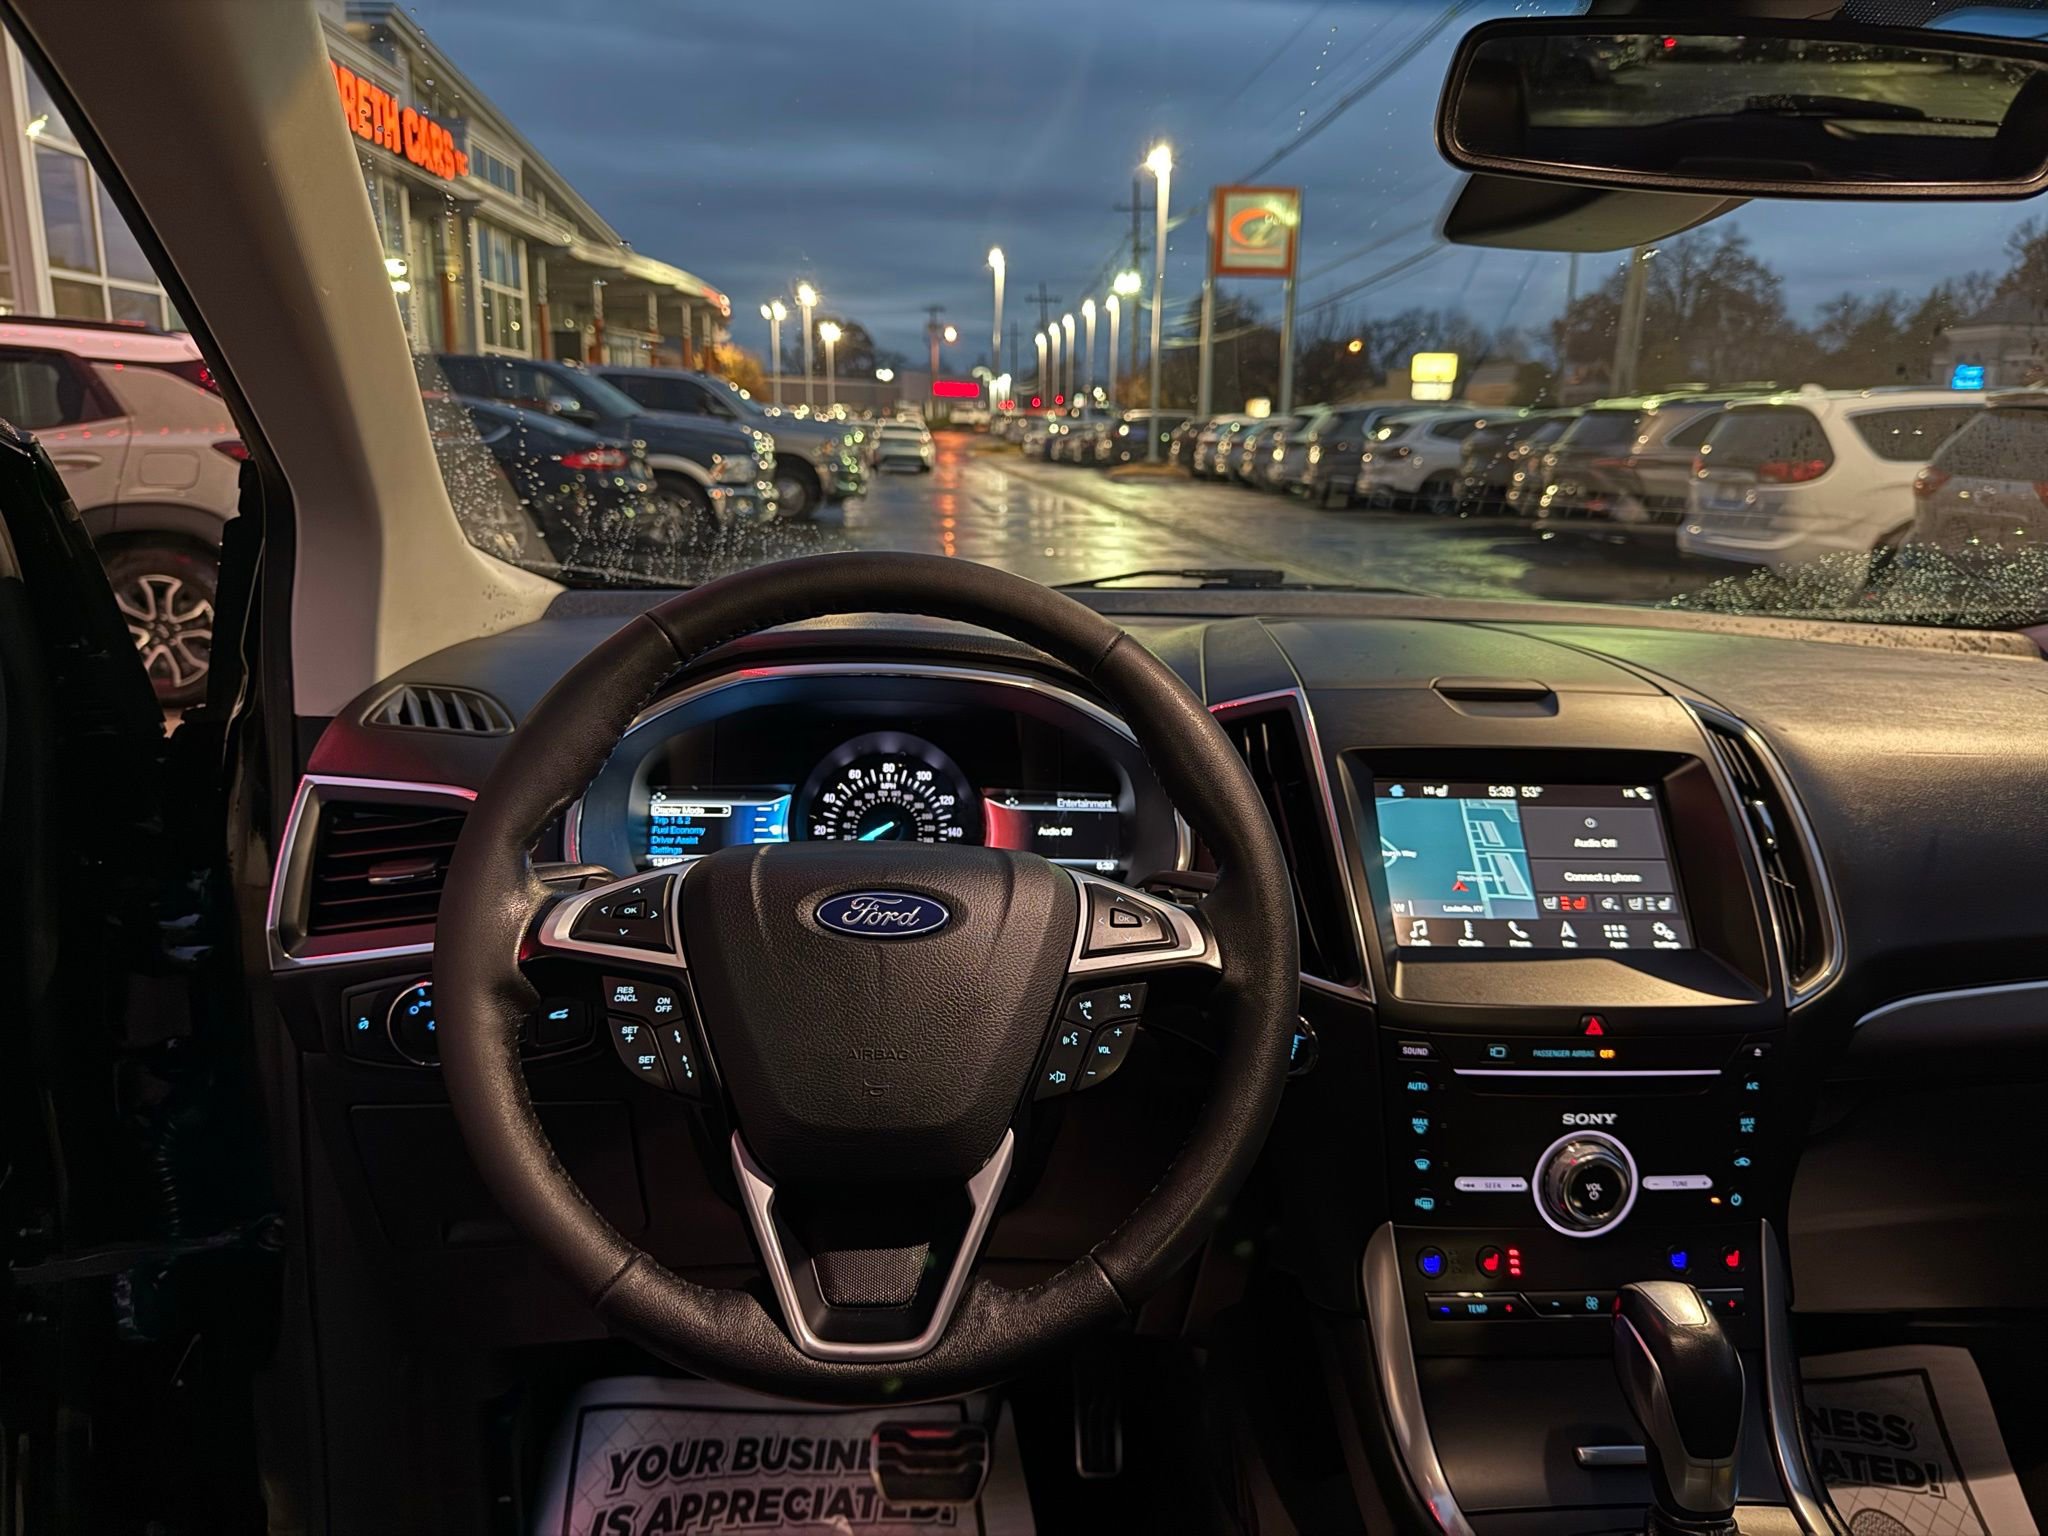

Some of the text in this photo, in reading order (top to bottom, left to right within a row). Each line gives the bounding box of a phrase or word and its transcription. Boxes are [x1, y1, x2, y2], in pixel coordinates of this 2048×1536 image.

[403, 106, 455, 181] CARS
[882, 763, 896, 773] 80
[848, 769, 861, 780] 60
[916, 770, 932, 781] 100
[880, 782, 897, 790] MPH
[1488, 785, 1517, 797] 5:39
[1521, 785, 1544, 798] 53°
[823, 793, 836, 803] 40
[938, 795, 955, 806] 120
[1057, 797, 1112, 808] Entertainment
[653, 816, 669, 826] Trip
[676, 816, 684, 825] &
[684, 816, 691, 825] 2
[651, 826, 706, 836] Fuel Economy
[813, 825, 827, 836] 20
[947, 827, 963, 837] 140
[1038, 827, 1073, 836] Audio Off
[651, 836, 699, 845] Driver Assist
[1574, 838, 1618, 848] Audio Off
[651, 846, 683, 856] Settings
[1563, 871, 1604, 882] Connect
[1611, 873, 1642, 884] phone
[842, 896, 922, 926] Ford
[1118, 914, 1130, 923] OK
[616, 986, 635, 994] RES
[614, 994, 638, 1002] CNCL
[657, 997, 671, 1005] ON
[655, 1005, 672, 1013] OFF
[621, 1026, 639, 1034] SET
[847, 1047, 911, 1060] AIRBAG
[1098, 1046, 1111, 1054] VOL
[1402, 1046, 1429, 1056] SOUND
[1532, 1049, 1570, 1058] PASSENGER
[1571, 1049, 1596, 1058] AIRBAG
[638, 1056, 656, 1064] SET
[1407, 1082, 1429, 1091] AUTO
[1746, 1081, 1760, 1090] A/C
[1411, 1117, 1429, 1126] MAX
[1562, 1113, 1618, 1125] SONY
[1740, 1117, 1755, 1125] MAX
[1740, 1125, 1754, 1133] A/C
[1585, 1183, 1603, 1192] VOL
[1467, 1304, 1488, 1315] TEMP
[1804, 1406, 1913, 1448] NESS
[610, 1438, 726, 1490] YOUR
[1820, 1448, 1942, 1494] ATED!
[592, 1485, 954, 1536] IS APPRECIAT
